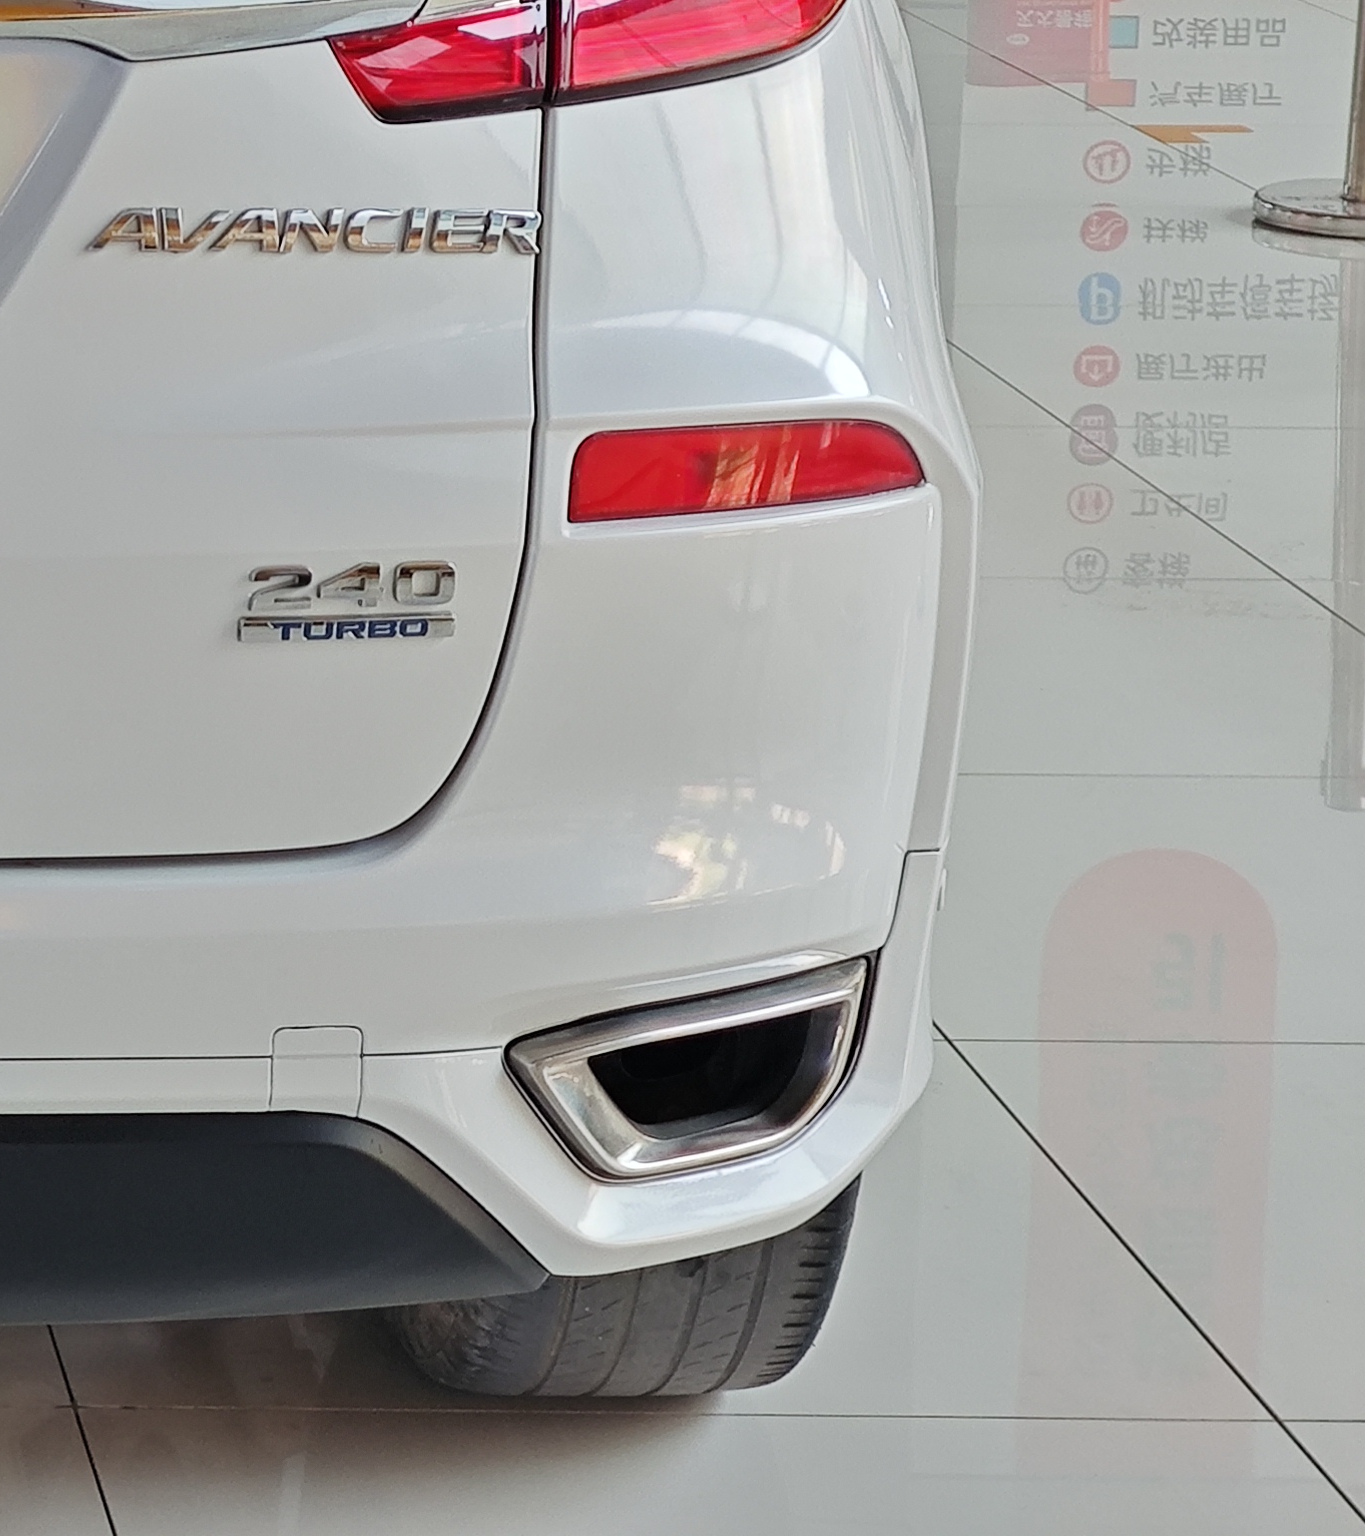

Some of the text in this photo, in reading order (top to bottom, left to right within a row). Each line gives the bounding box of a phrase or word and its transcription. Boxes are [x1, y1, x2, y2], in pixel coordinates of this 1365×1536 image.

[86, 206, 543, 256] AVANCIER
[248, 561, 458, 611] 240
[273, 617, 430, 642] TURBO
